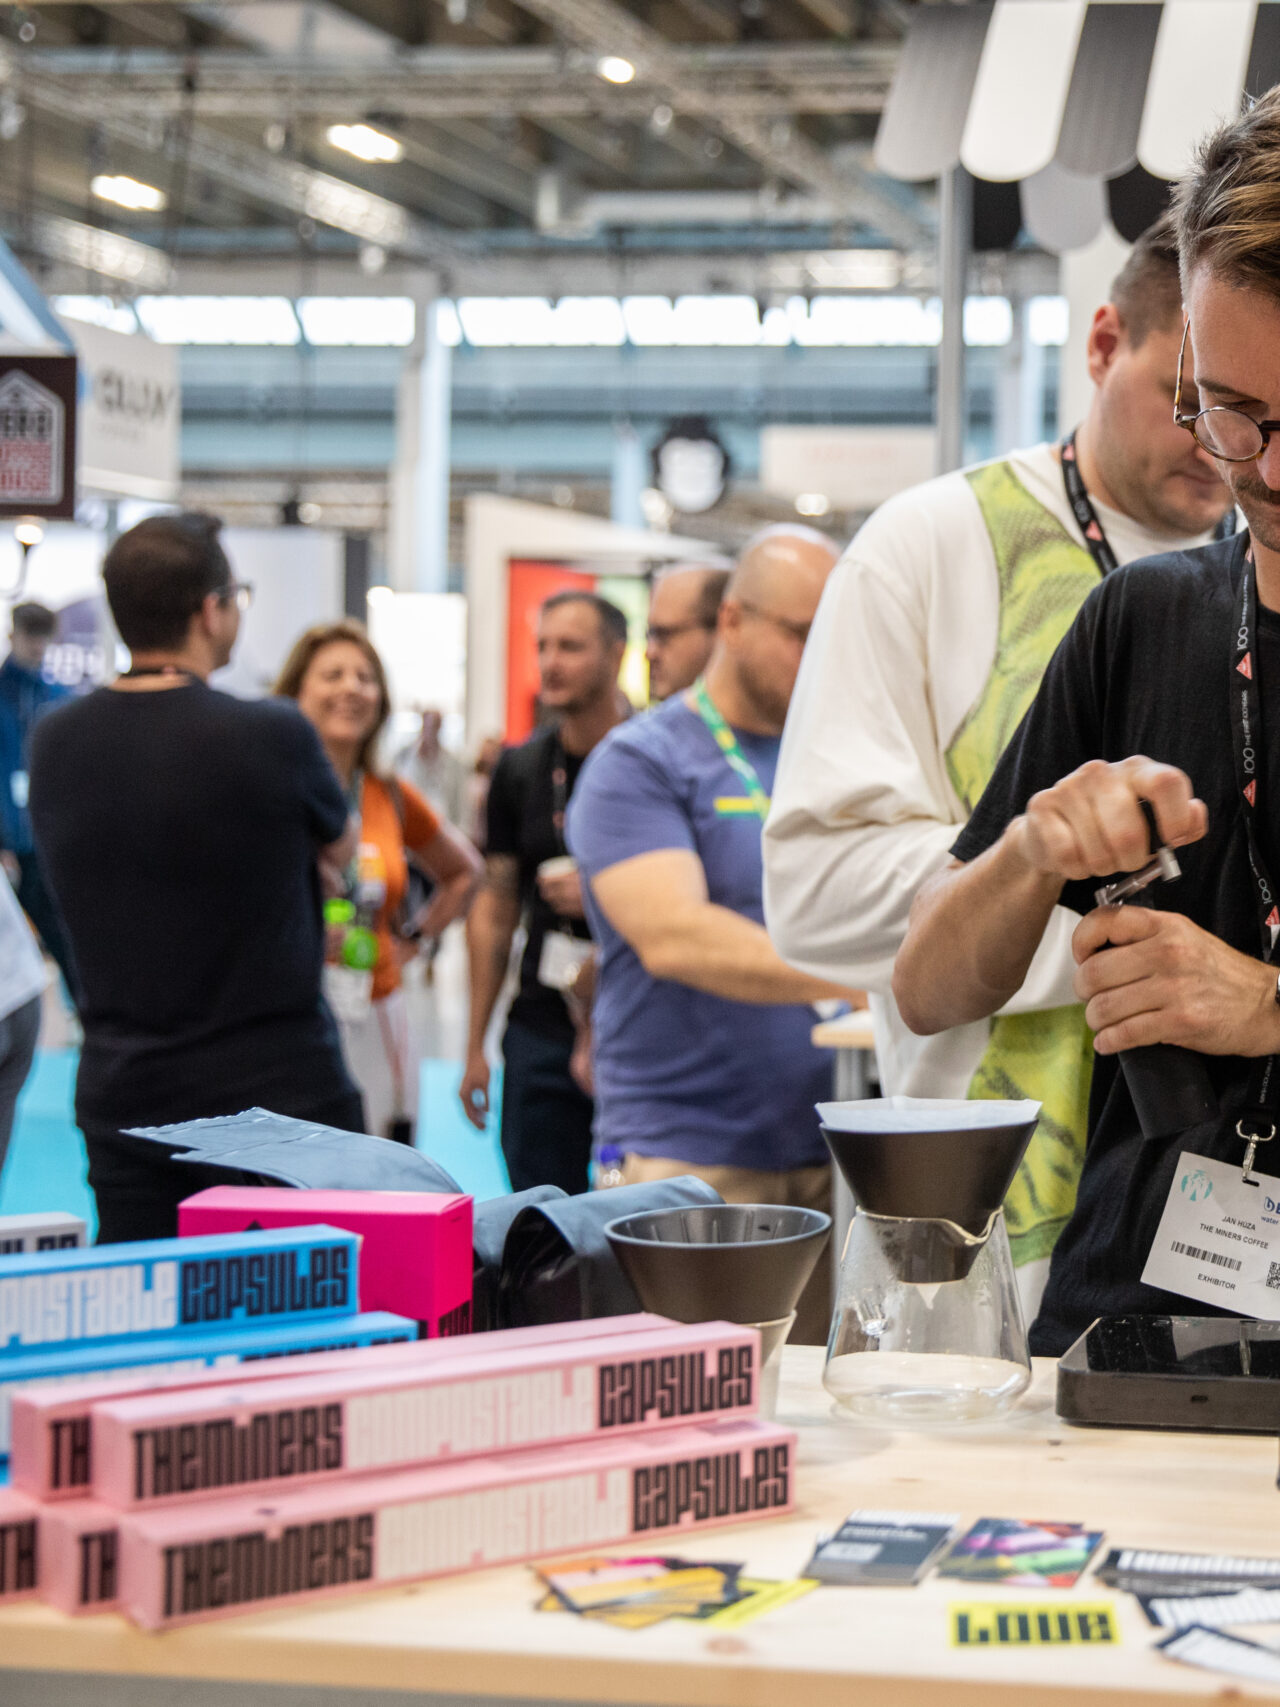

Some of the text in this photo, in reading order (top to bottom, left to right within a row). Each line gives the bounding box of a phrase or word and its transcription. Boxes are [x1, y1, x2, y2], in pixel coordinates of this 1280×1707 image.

[1236, 626, 1249, 651] 100
[1242, 747, 1256, 774] 100
[1257, 878, 1272, 904] 100
[1221, 1216, 1237, 1225] JAN
[1261, 1216, 1279, 1225] water
[1199, 1223, 1269, 1249] THE MINERS COFFEE
[1197, 1273, 1236, 1291] EXHIBITOR
